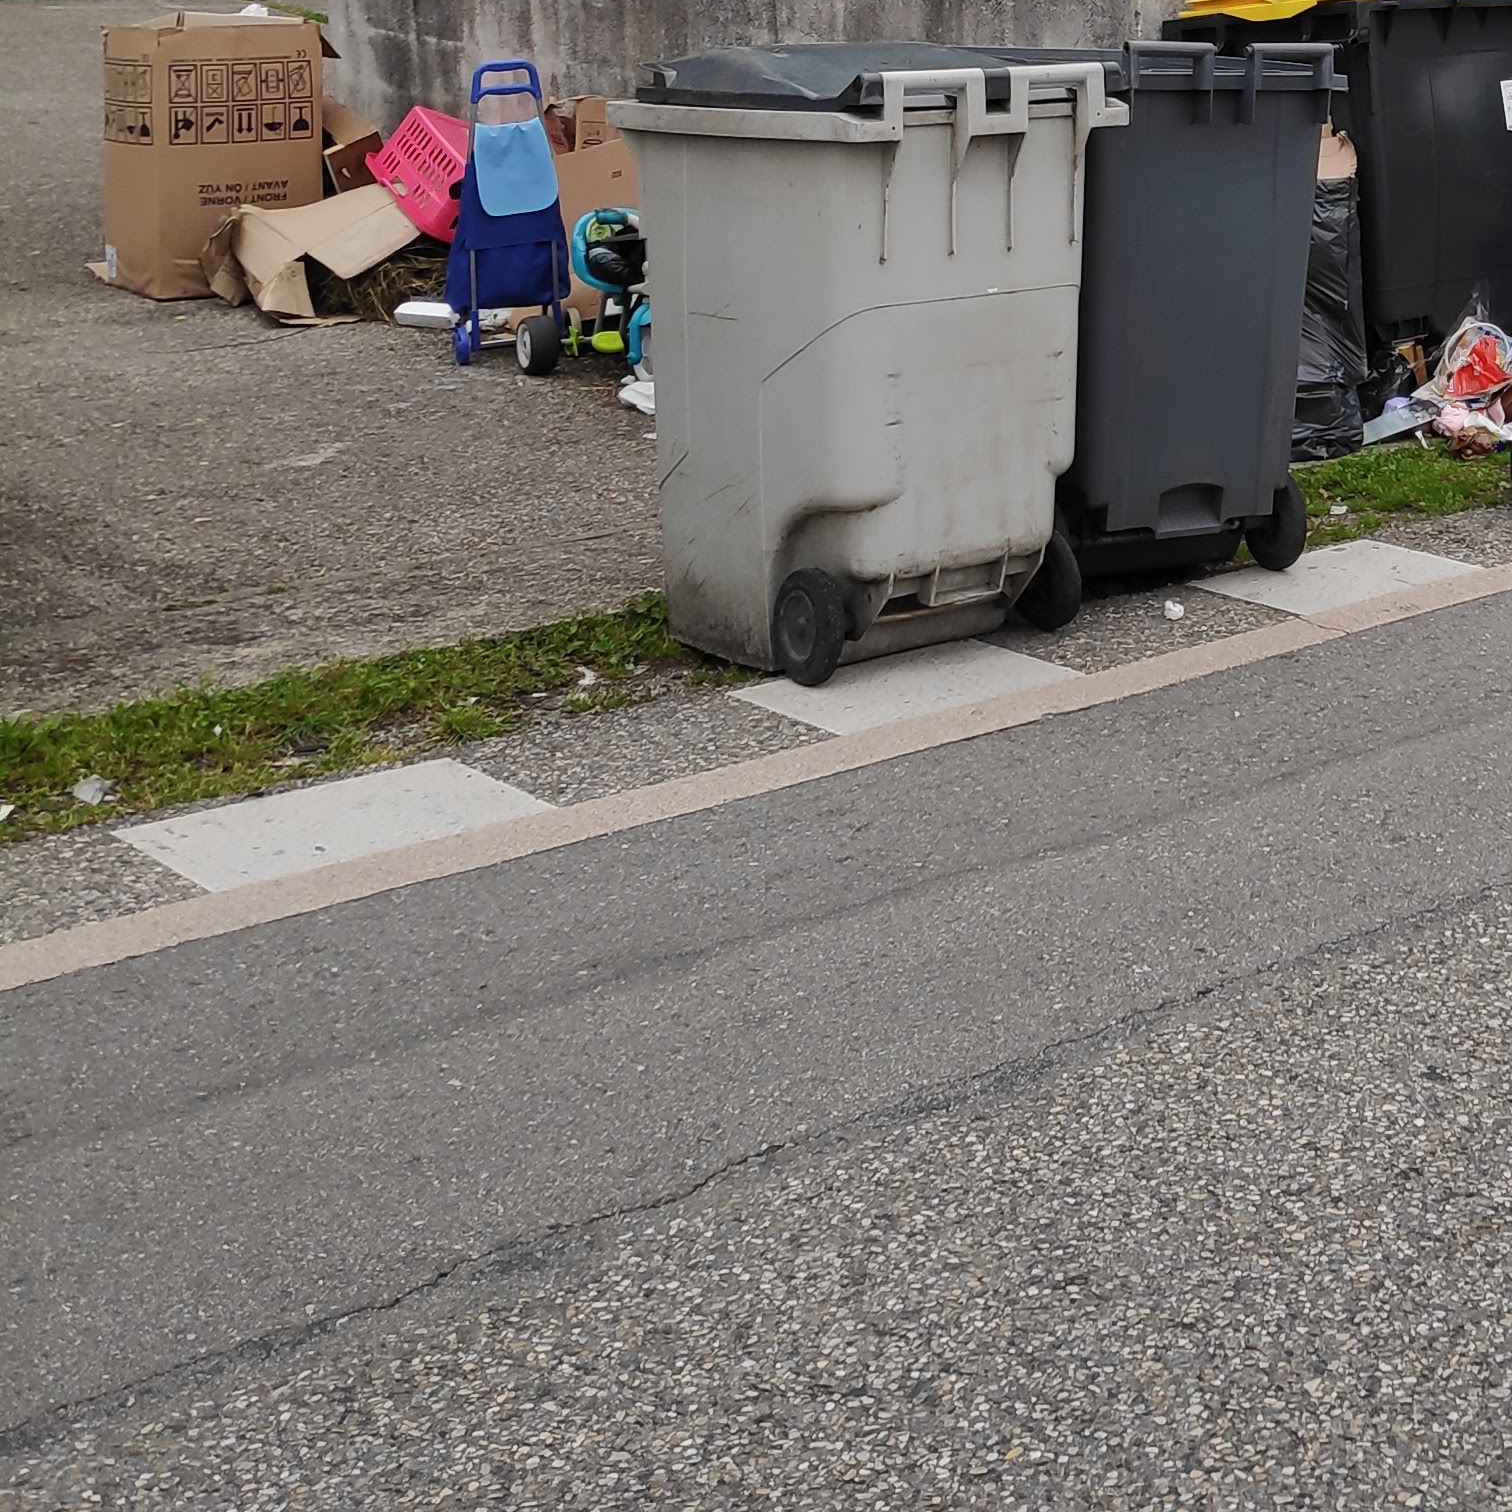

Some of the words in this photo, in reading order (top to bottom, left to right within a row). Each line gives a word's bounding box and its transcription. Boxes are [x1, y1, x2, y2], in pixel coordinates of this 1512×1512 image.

[252, 180, 289, 191] AVANT
[201, 196, 241, 206] VORNE
[251, 192, 287, 203] FRONT
